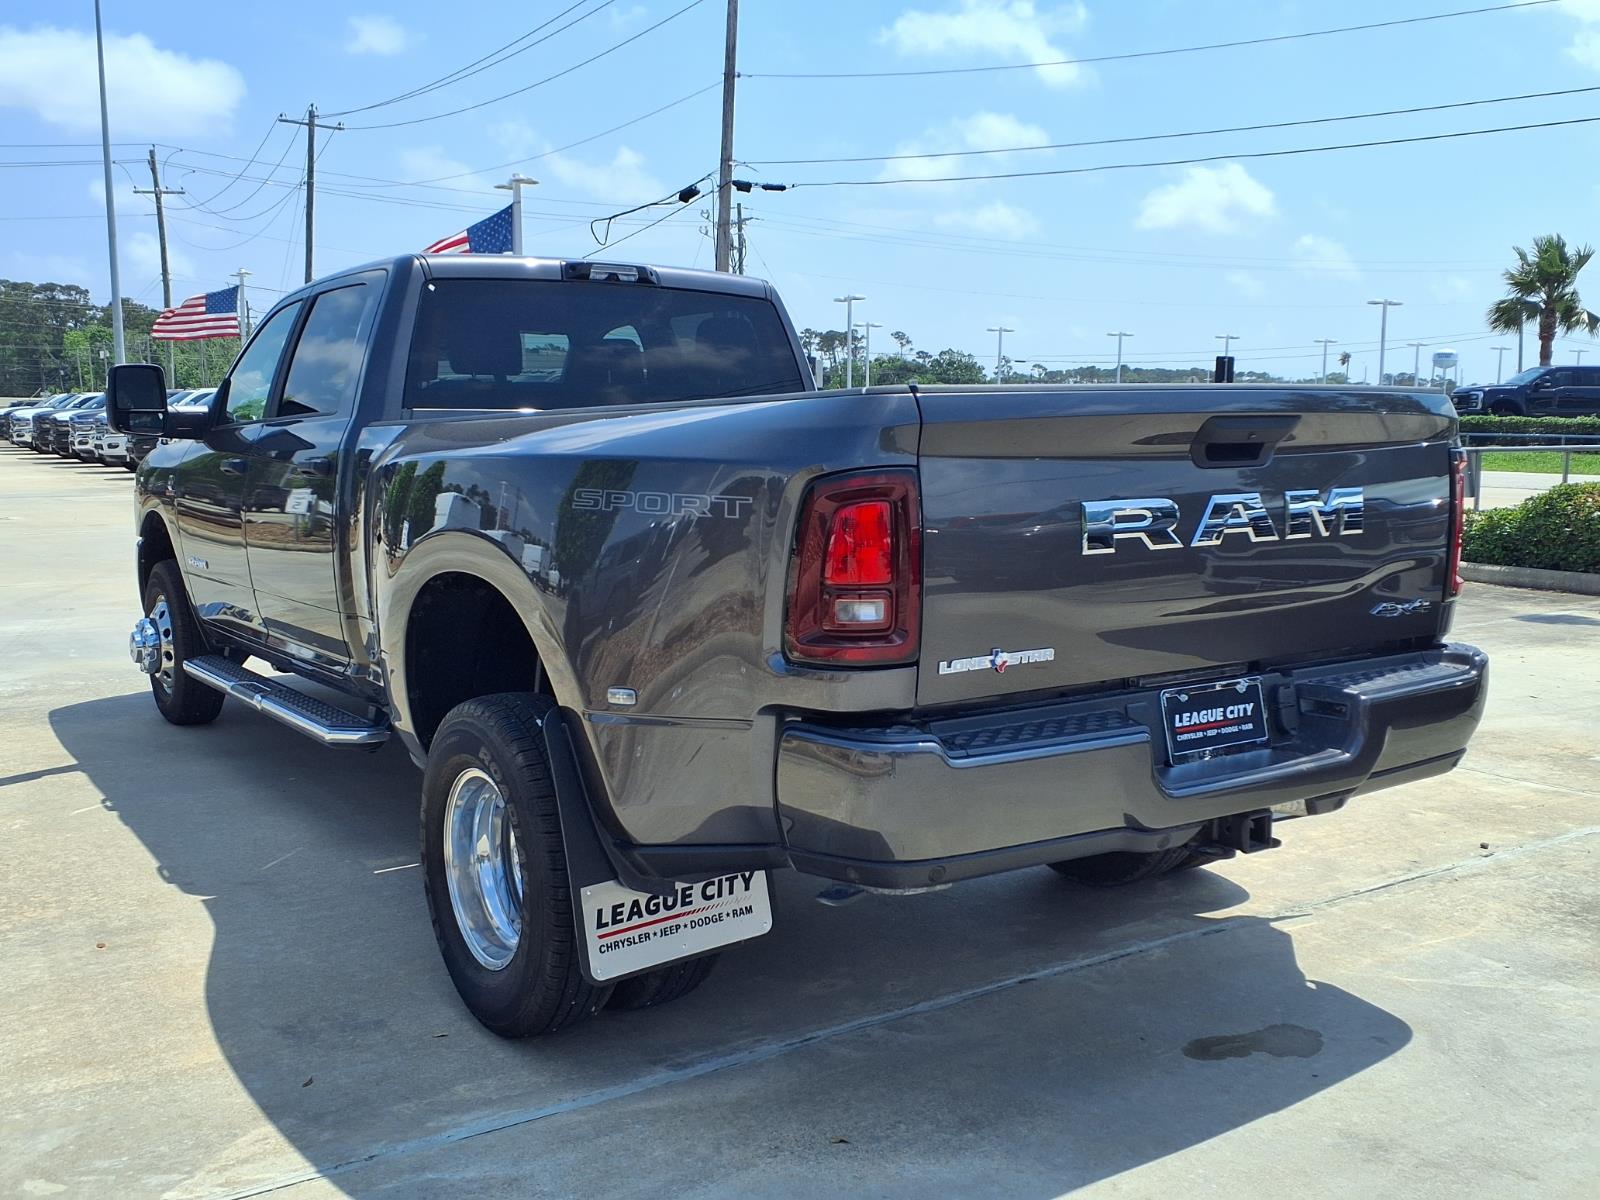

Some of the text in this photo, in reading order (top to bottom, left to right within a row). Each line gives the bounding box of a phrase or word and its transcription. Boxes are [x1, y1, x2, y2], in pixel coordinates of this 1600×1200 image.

[572, 488, 753, 519] SPORT
[1081, 487, 1364, 555] RAM
[939, 648, 1055, 675] LONE STAR
[1175, 703, 1254, 727] LEAGUE CITY
[1177, 732, 1204, 741] CHRYSLER
[596, 871, 756, 929] LEAGUE CITY
[599, 904, 754, 954] CHRYSLER JEEP DODGE RAM
